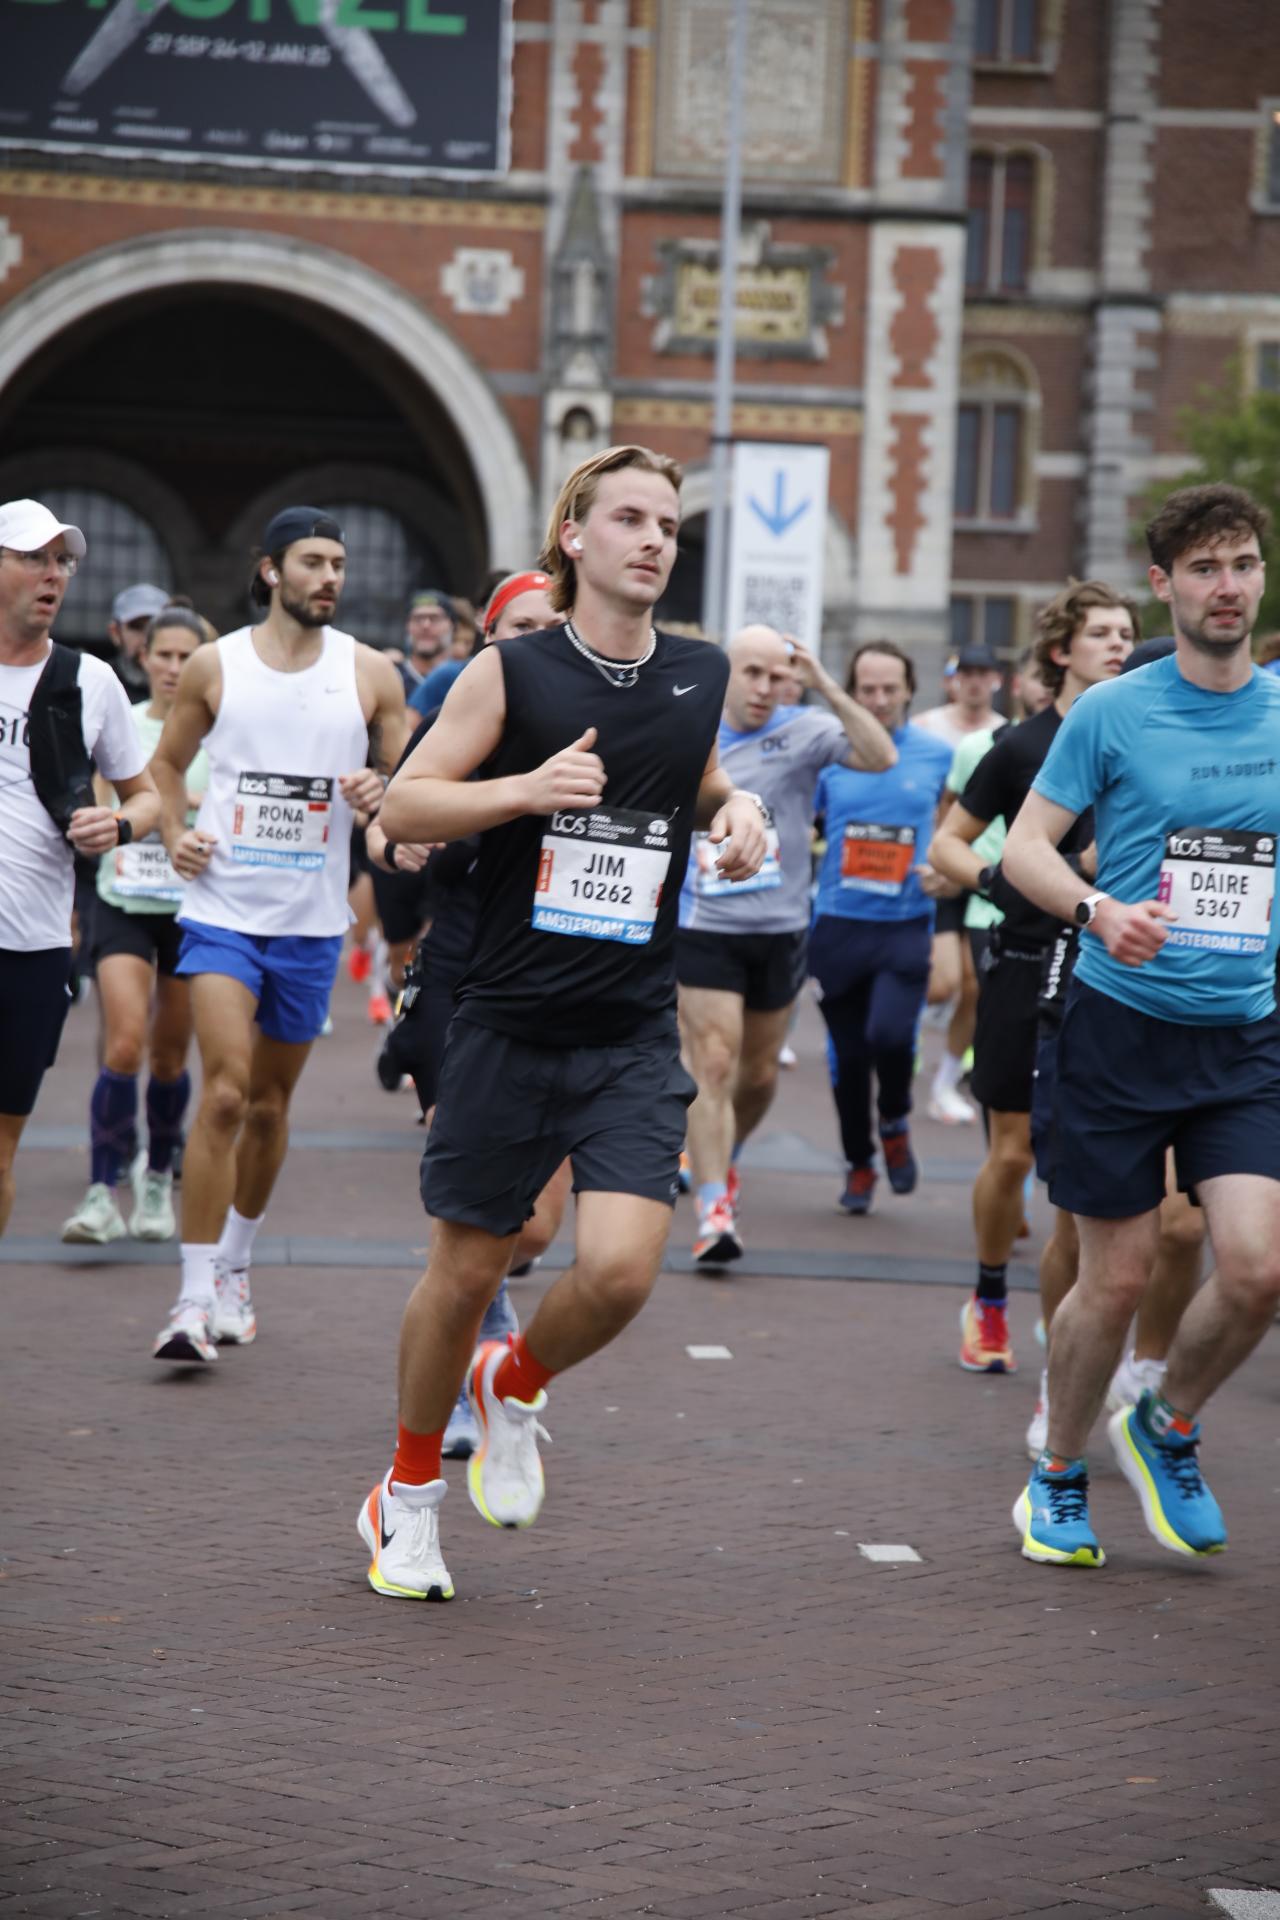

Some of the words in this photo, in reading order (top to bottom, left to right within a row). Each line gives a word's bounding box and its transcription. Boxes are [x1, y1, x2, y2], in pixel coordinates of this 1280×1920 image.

[1191, 766, 1220, 780] RUN
[258, 805, 304, 823] RONA
[551, 810, 588, 835] tcs
[256, 825, 303, 842] 24665
[1169, 835, 1202, 857] tcs
[583, 853, 626, 878] JIM
[570, 879, 633, 904] 10262
[1190, 867, 1249, 895] DÁIRE
[1194, 898, 1242, 919] 5367
[536, 910, 625, 937] AMSTERDAM
[1166, 930, 1241, 952] MSTERDAM
